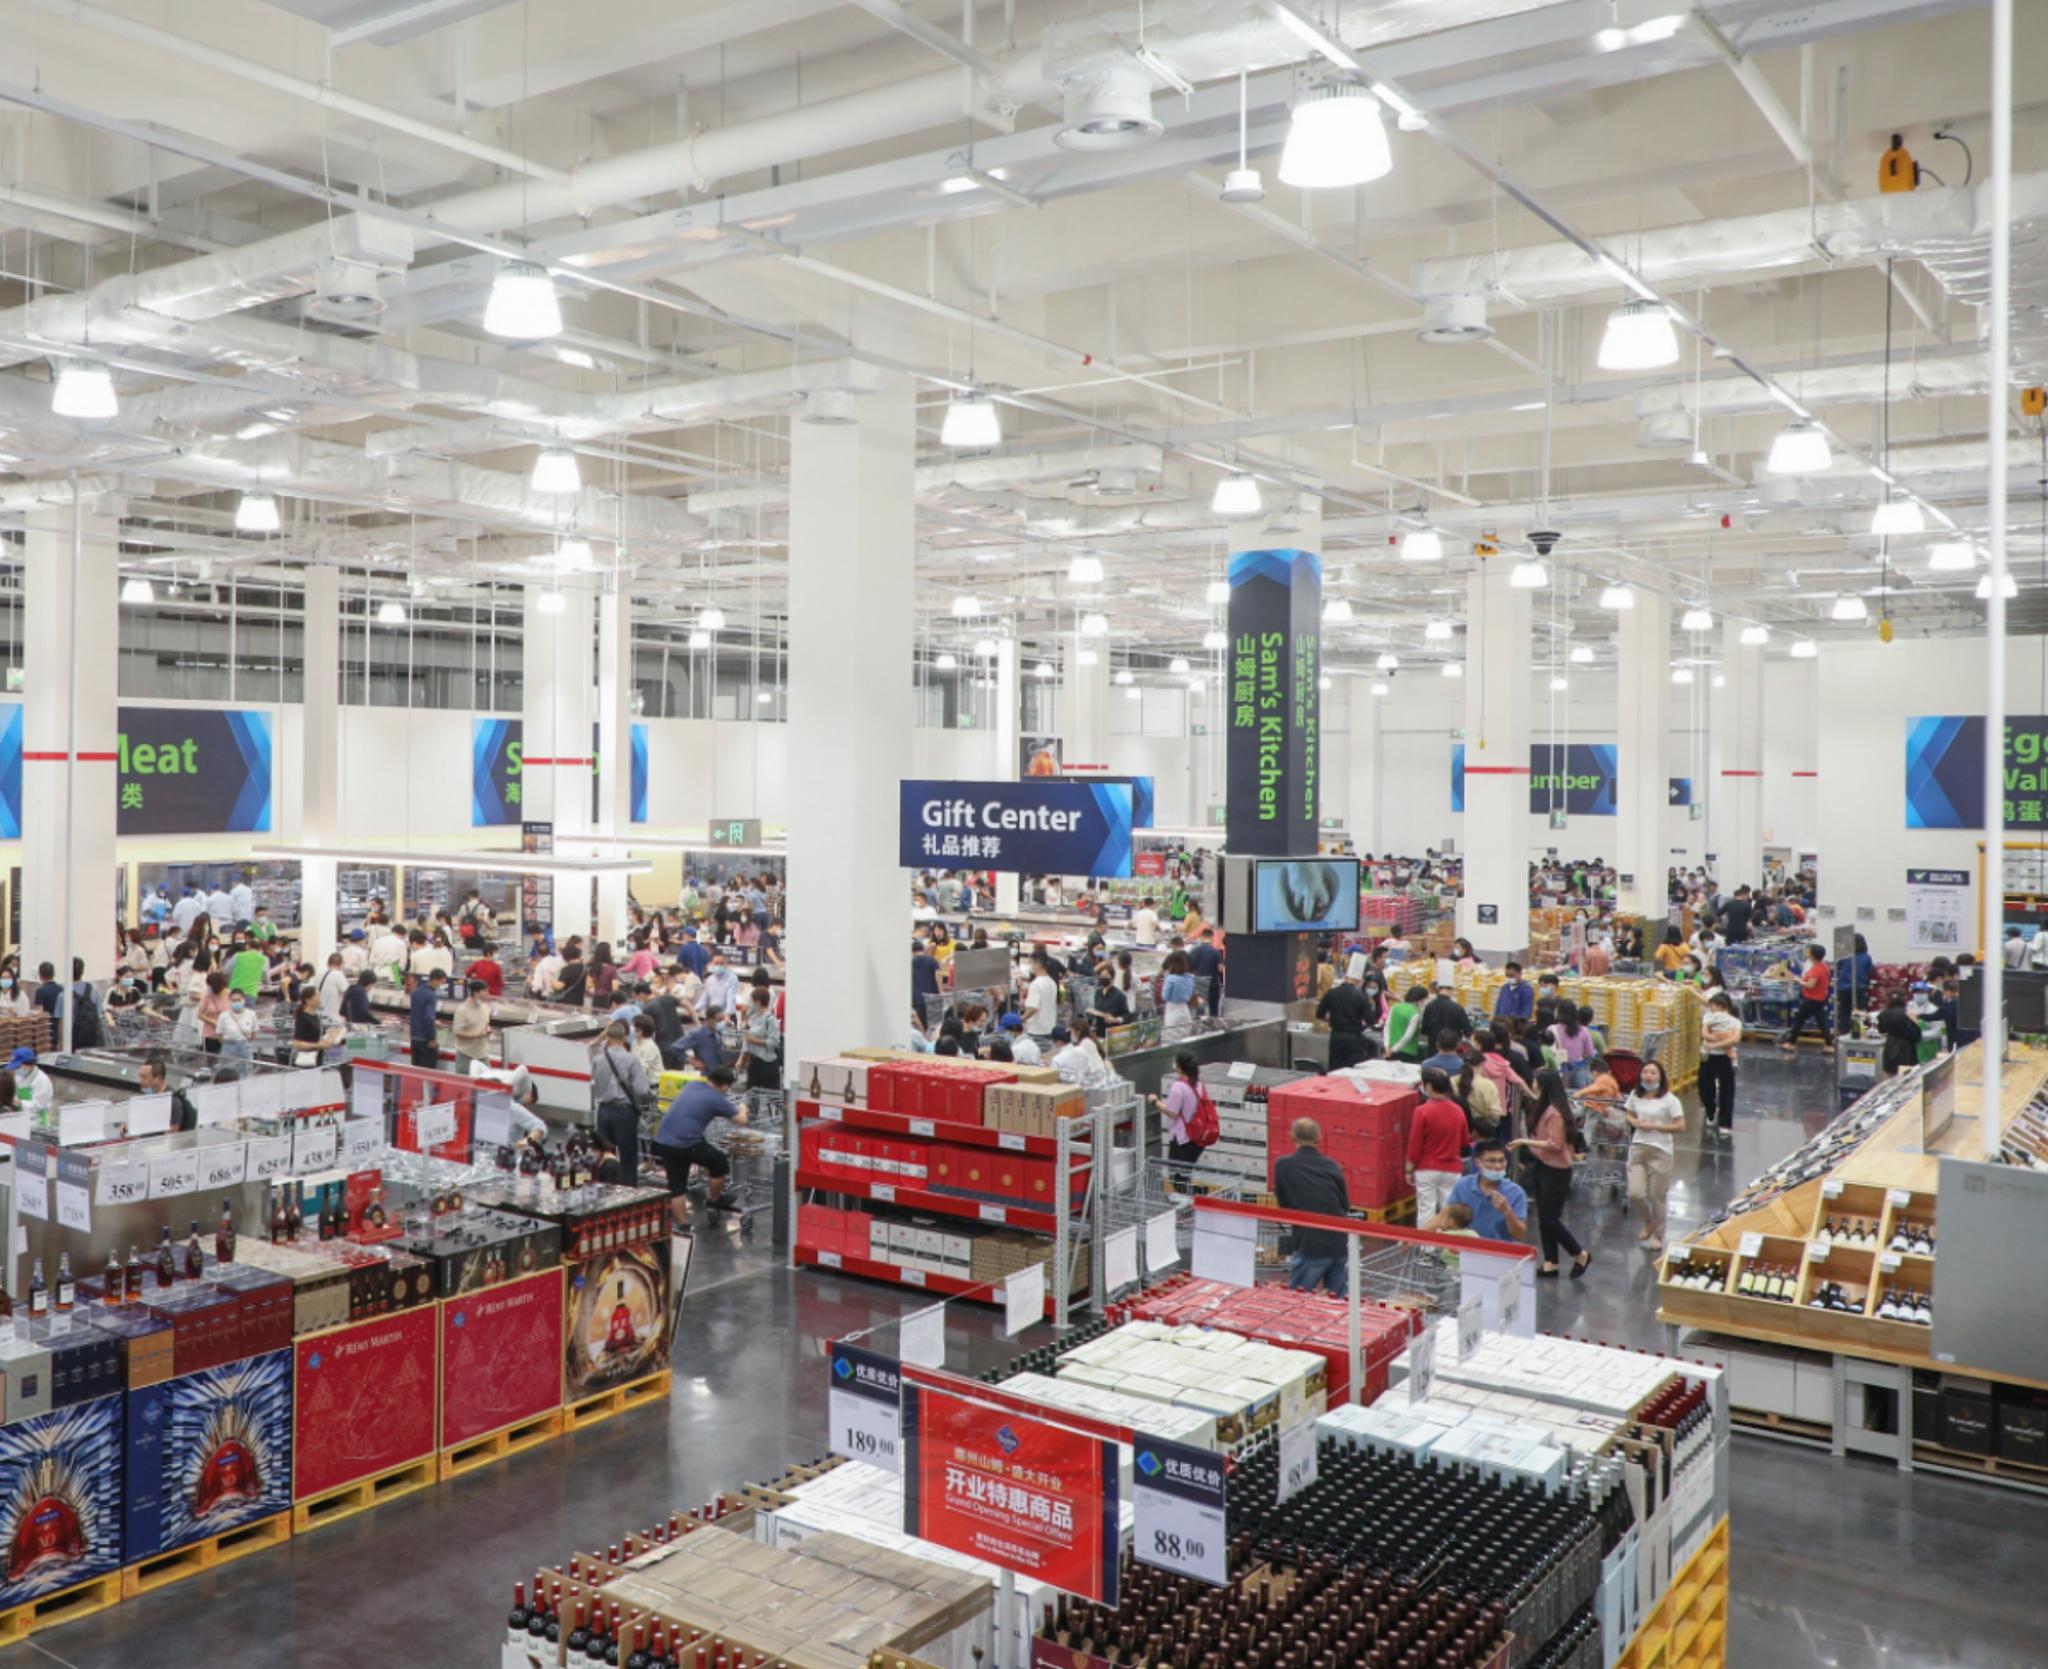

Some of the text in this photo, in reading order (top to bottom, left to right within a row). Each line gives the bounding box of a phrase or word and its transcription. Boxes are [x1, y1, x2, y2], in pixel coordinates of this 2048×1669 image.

[1259, 632, 1283, 821] Sam's Kitchen
[1304, 718, 1316, 820] Kitchen
[922, 800, 1081, 832] Gift Center
[922, 833, 1001, 858] 礼品推荐
[1165, 1458, 1221, 1487] 优质优价
[945, 1467, 1073, 1530] 开业特惠商品
[1154, 1529, 1205, 1561] 88.00
